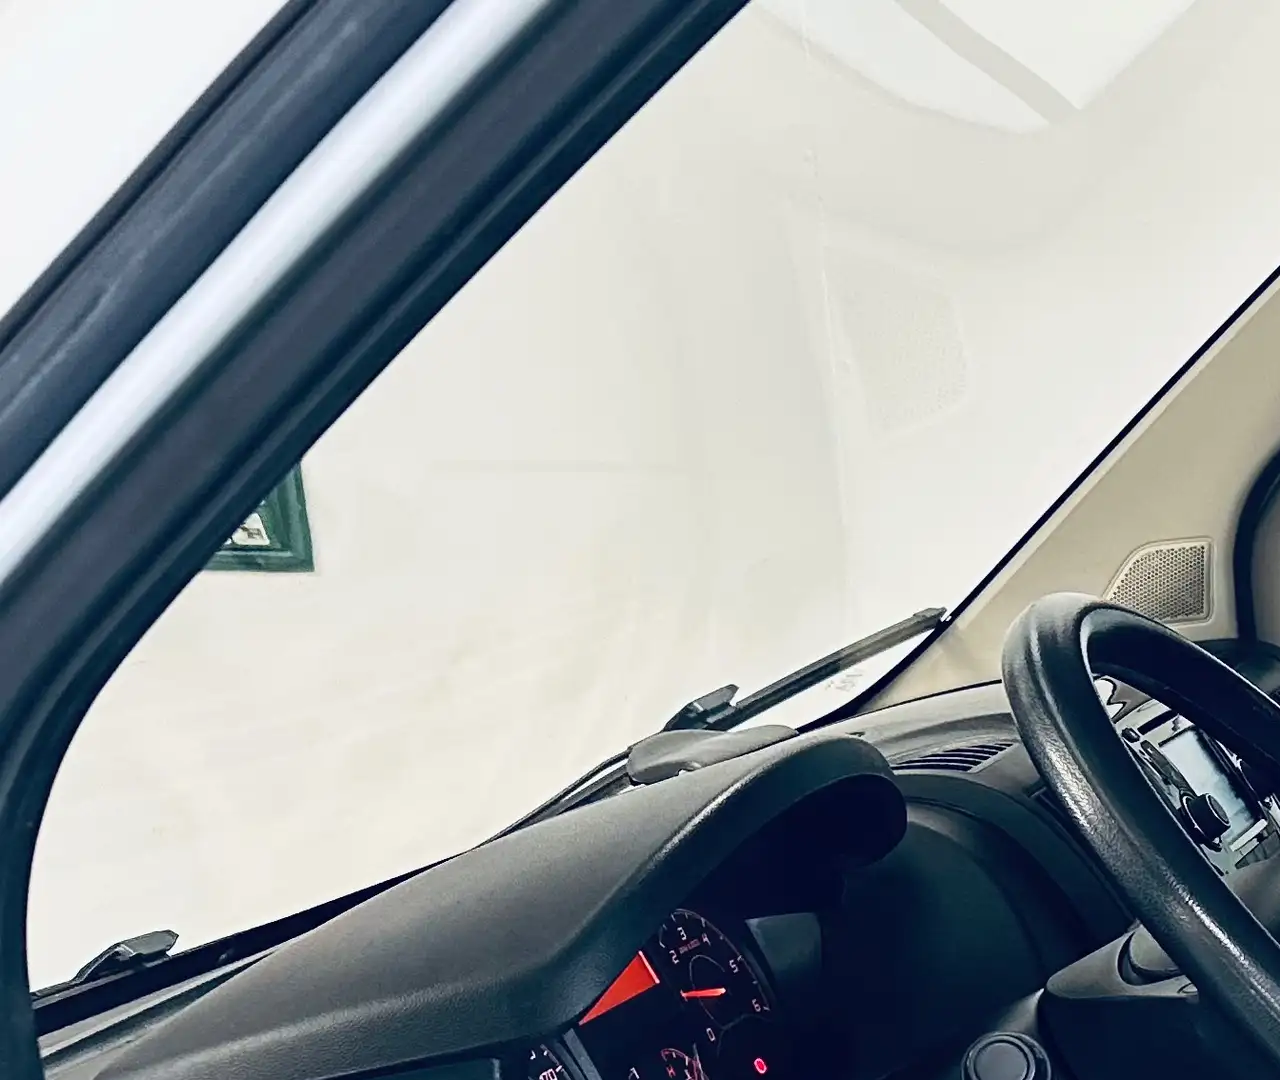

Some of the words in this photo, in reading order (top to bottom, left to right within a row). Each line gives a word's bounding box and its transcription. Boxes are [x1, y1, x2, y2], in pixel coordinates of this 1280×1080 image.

[677, 927, 687, 940] 3
[669, 950, 679, 964] 2
[729, 960, 739, 973] 5
[752, 998, 761, 1012] 6
